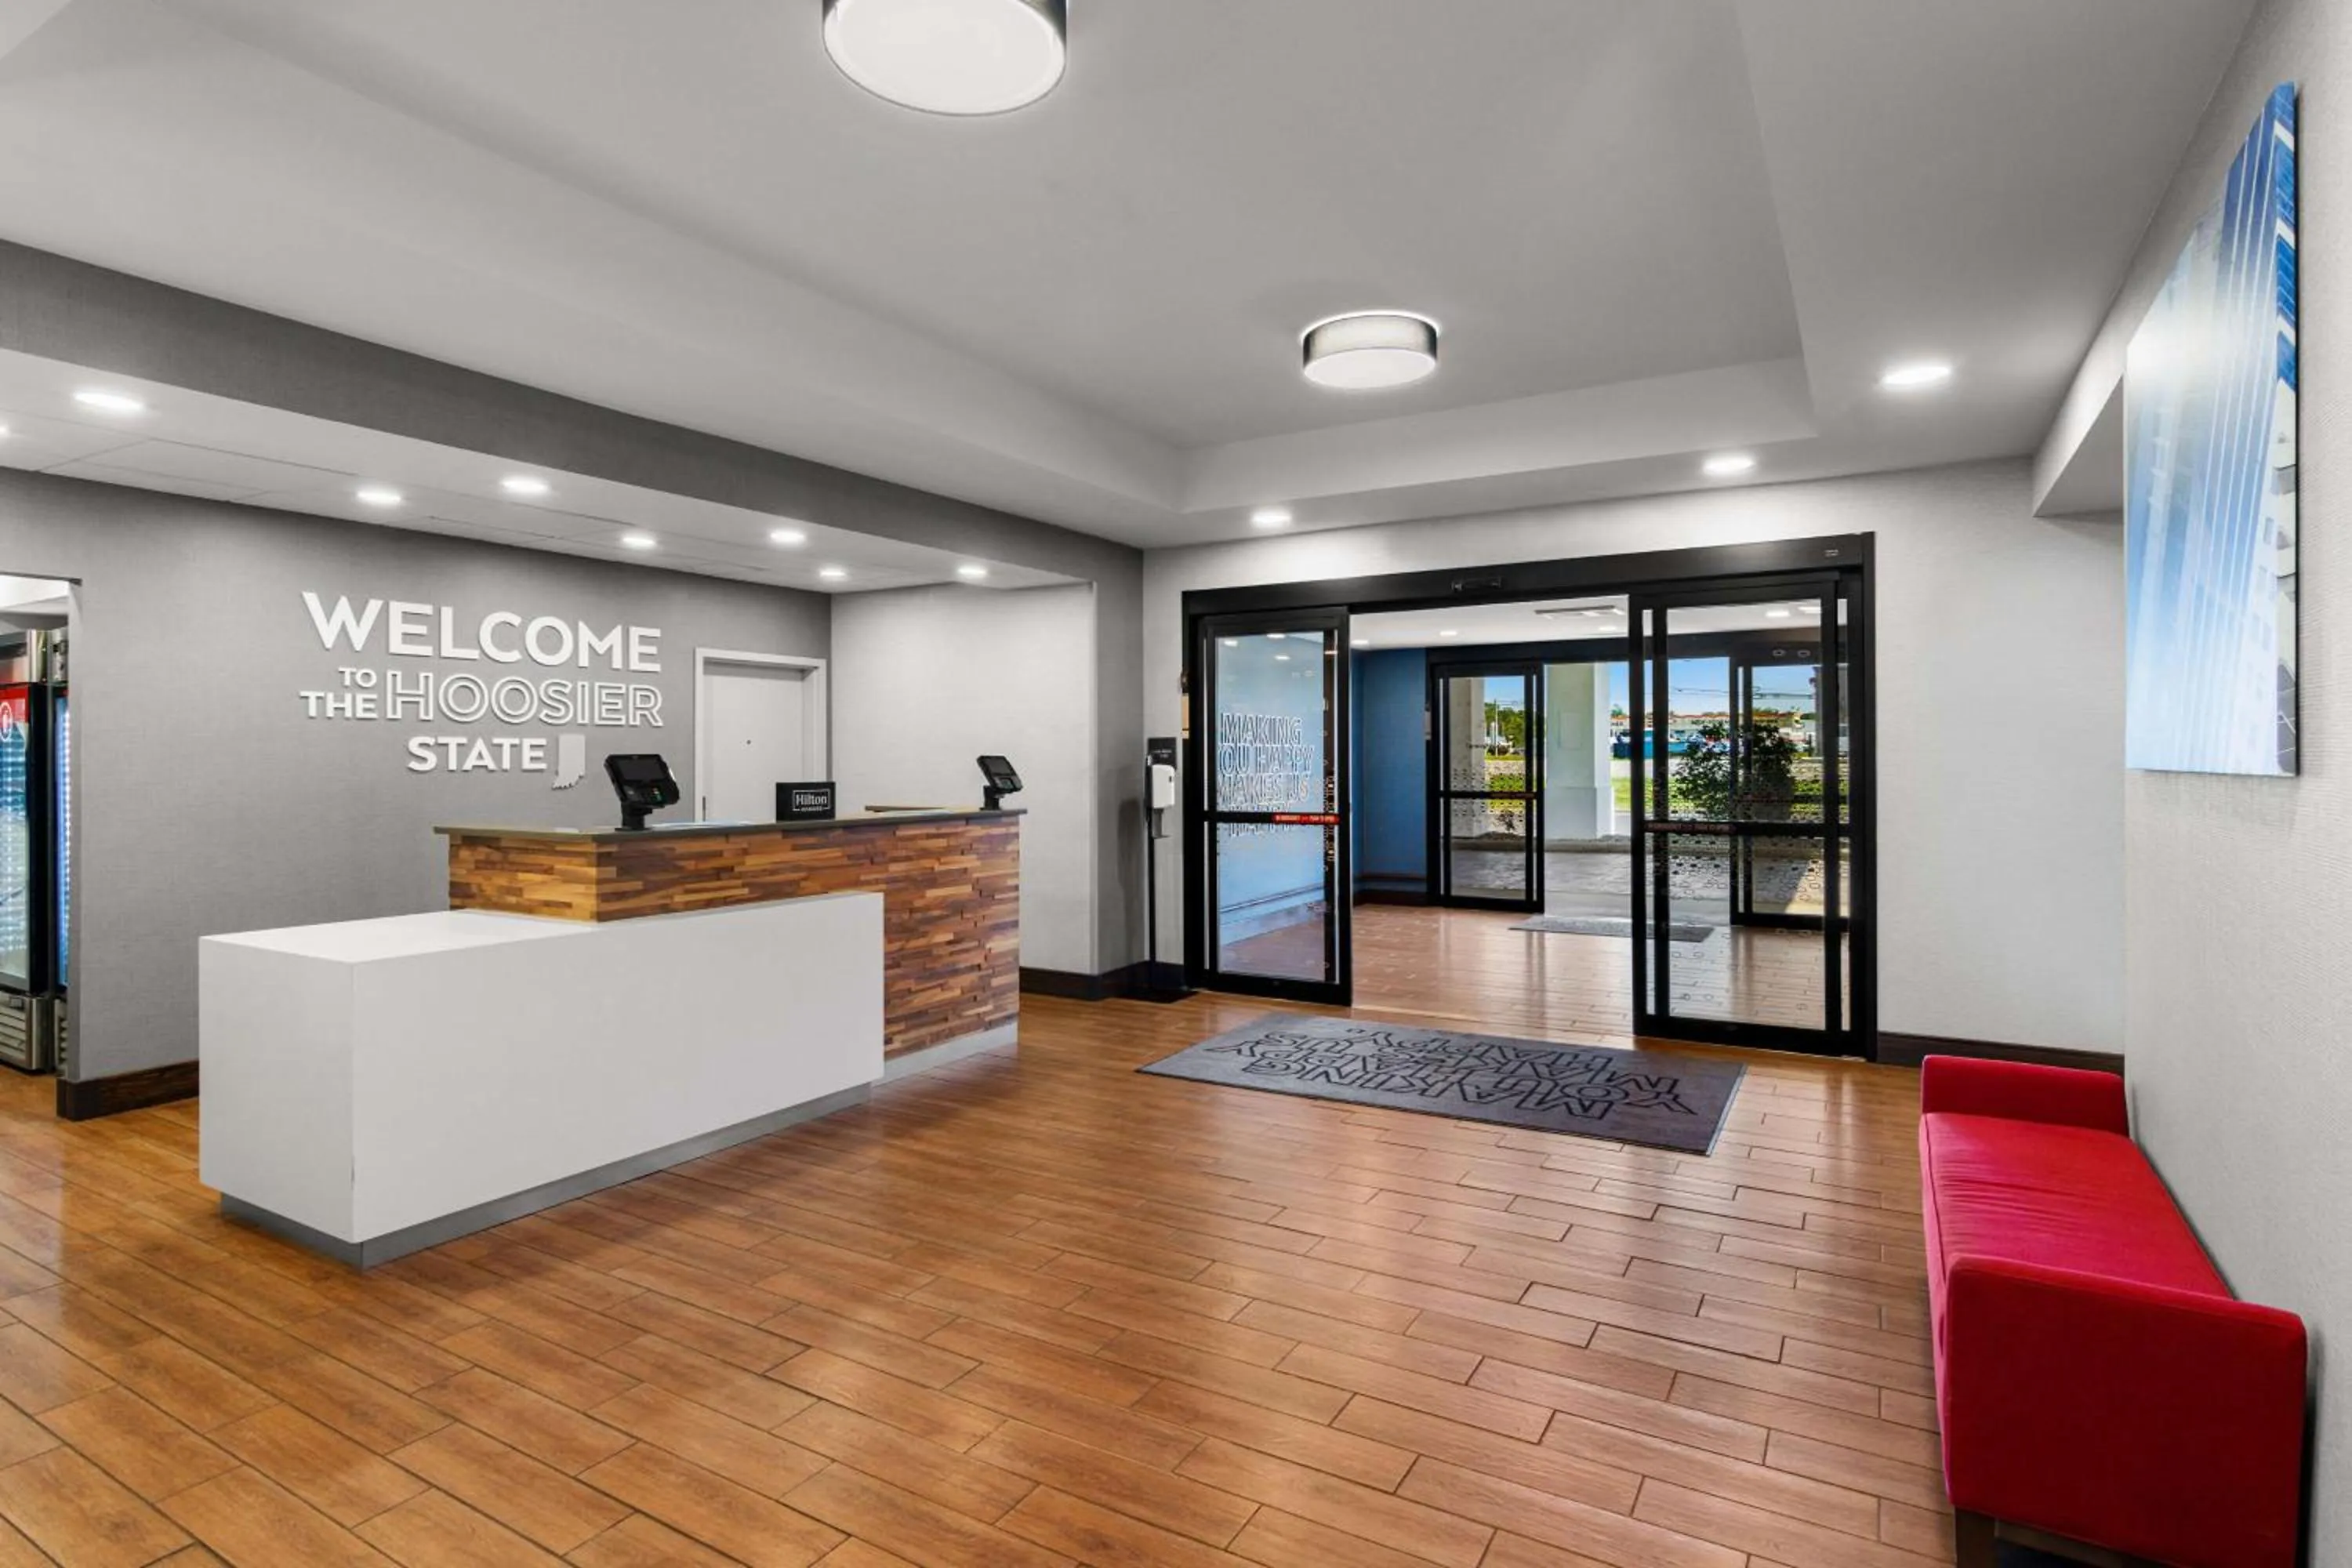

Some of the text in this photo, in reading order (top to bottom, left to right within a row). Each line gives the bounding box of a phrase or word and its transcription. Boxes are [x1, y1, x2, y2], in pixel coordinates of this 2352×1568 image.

[301, 590, 662, 673] WELCOME
[338, 666, 377, 688] TO
[299, 669, 664, 728] THE HOOSIER
[1221, 713, 1303, 746] MAKING
[407, 735, 548, 772] STATE
[796, 793, 827, 805] Hilton
